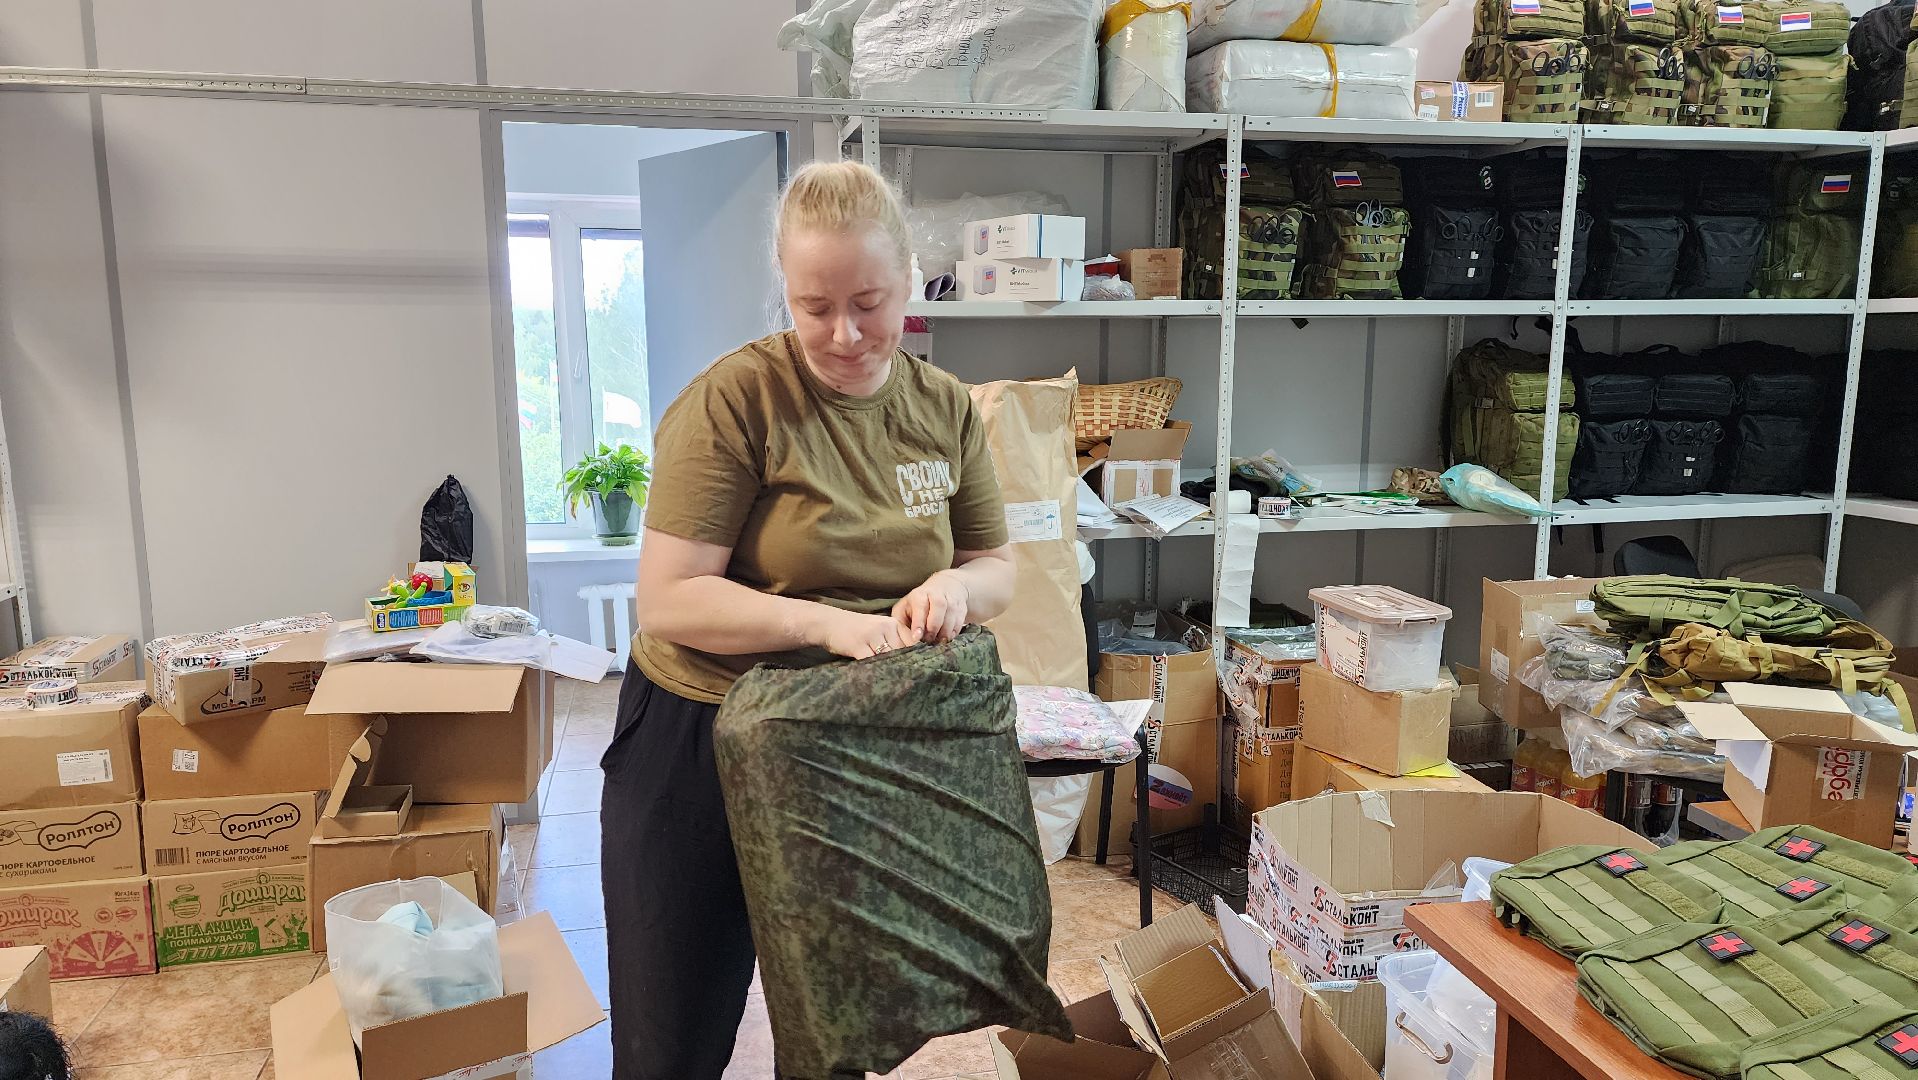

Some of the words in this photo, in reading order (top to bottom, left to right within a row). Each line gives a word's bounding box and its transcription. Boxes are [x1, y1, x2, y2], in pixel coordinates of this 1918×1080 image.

[918, 488, 945, 503] НЕ
[1261, 731, 1300, 742] СТАЛЬКОН
[222, 844, 289, 856] КАРТОФЕЛЬНОЕ
[26, 856, 96, 868] КАРТОФЕЛЬНОЕ
[5, 867, 57, 878] сухариками
[1324, 899, 1379, 926] СТАЛЬКОНТ
[163, 923, 203, 939] МЕГА
[205, 917, 253, 936] АКЦИЯ
[170, 937, 211, 947] ПОЙМАЙ
